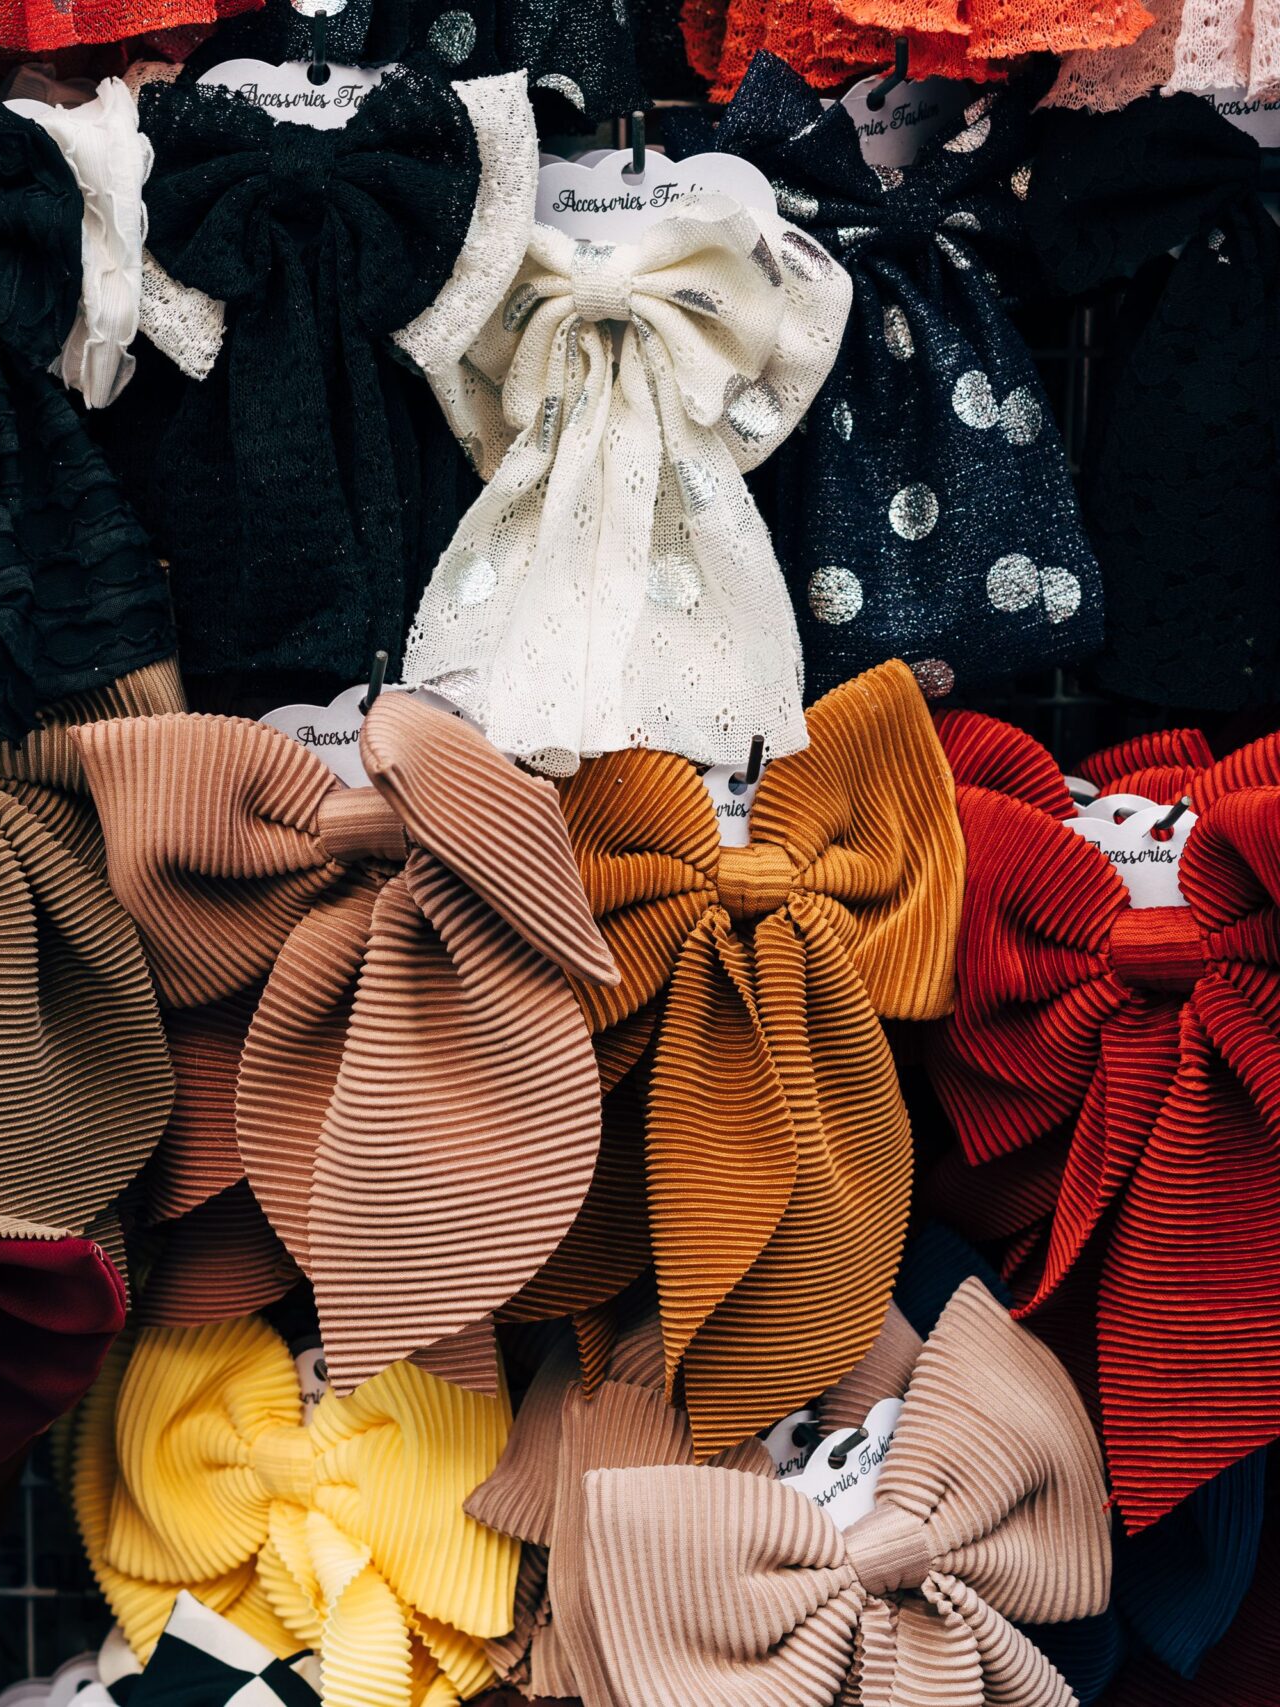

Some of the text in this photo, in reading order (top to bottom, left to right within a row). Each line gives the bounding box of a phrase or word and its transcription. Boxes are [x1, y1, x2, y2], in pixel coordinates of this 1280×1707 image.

[239, 83, 331, 108] Accessories
[552, 190, 646, 212] Accessories
[294, 726, 361, 746] Accesso
[1087, 841, 1177, 864] cessories
